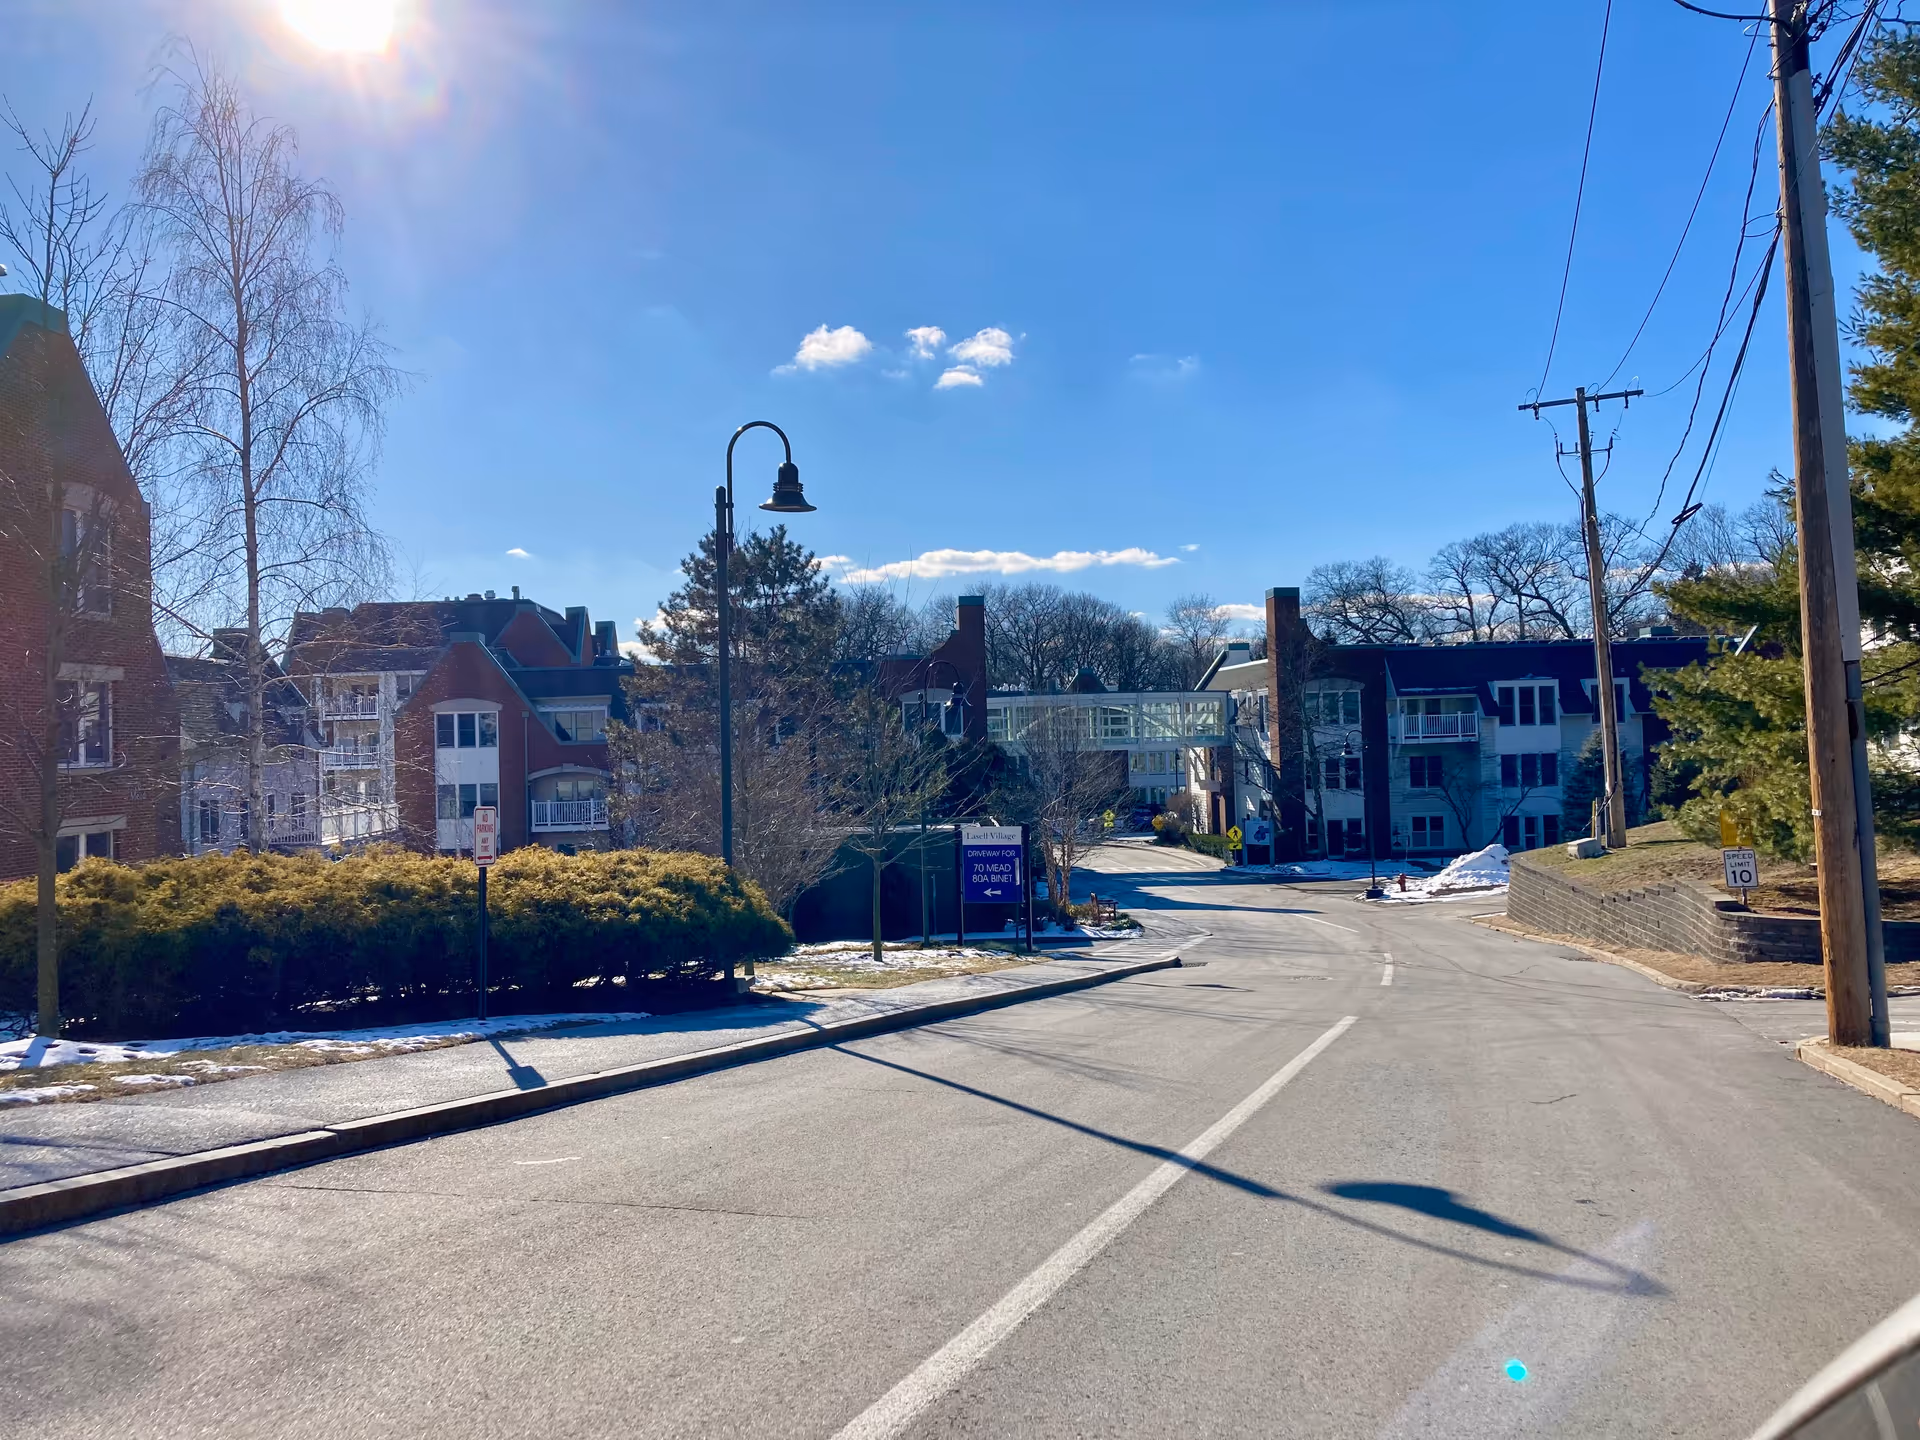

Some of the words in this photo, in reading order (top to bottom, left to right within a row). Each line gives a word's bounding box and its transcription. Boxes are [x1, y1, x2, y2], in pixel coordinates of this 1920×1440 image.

[477, 824, 493, 833] PARKING
[966, 832, 988, 840] Lasell
[989, 832, 1016, 840] Village
[973, 863, 985, 872] 70
[986, 863, 1012, 872] MEAD
[972, 874, 989, 883] 80A
[990, 874, 1013, 883] BINET
[1731, 869, 1752, 884] 10
